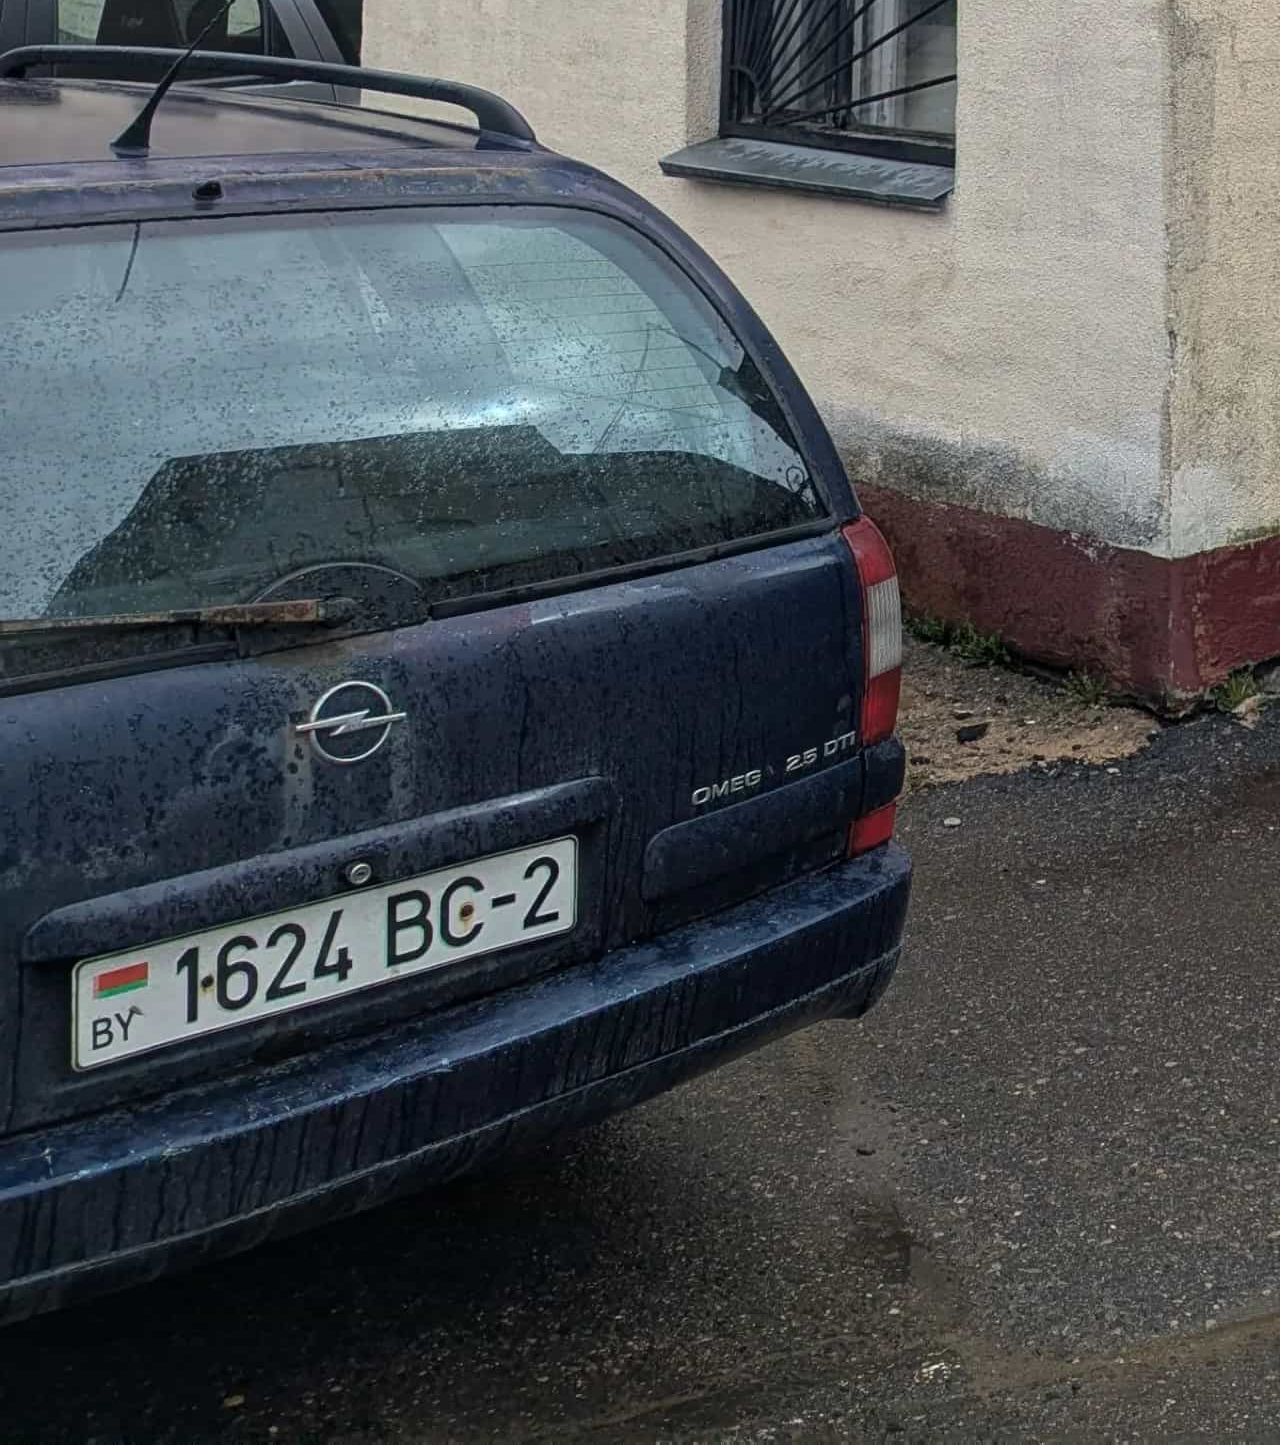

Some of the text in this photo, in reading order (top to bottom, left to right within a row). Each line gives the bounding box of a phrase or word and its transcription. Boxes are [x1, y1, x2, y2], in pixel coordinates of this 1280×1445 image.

[691, 765, 775, 805] OMEG
[823, 730, 856, 757] DTI
[176, 856, 560, 1024] 1624 BC-2
[92, 1011, 135, 1052] BY
